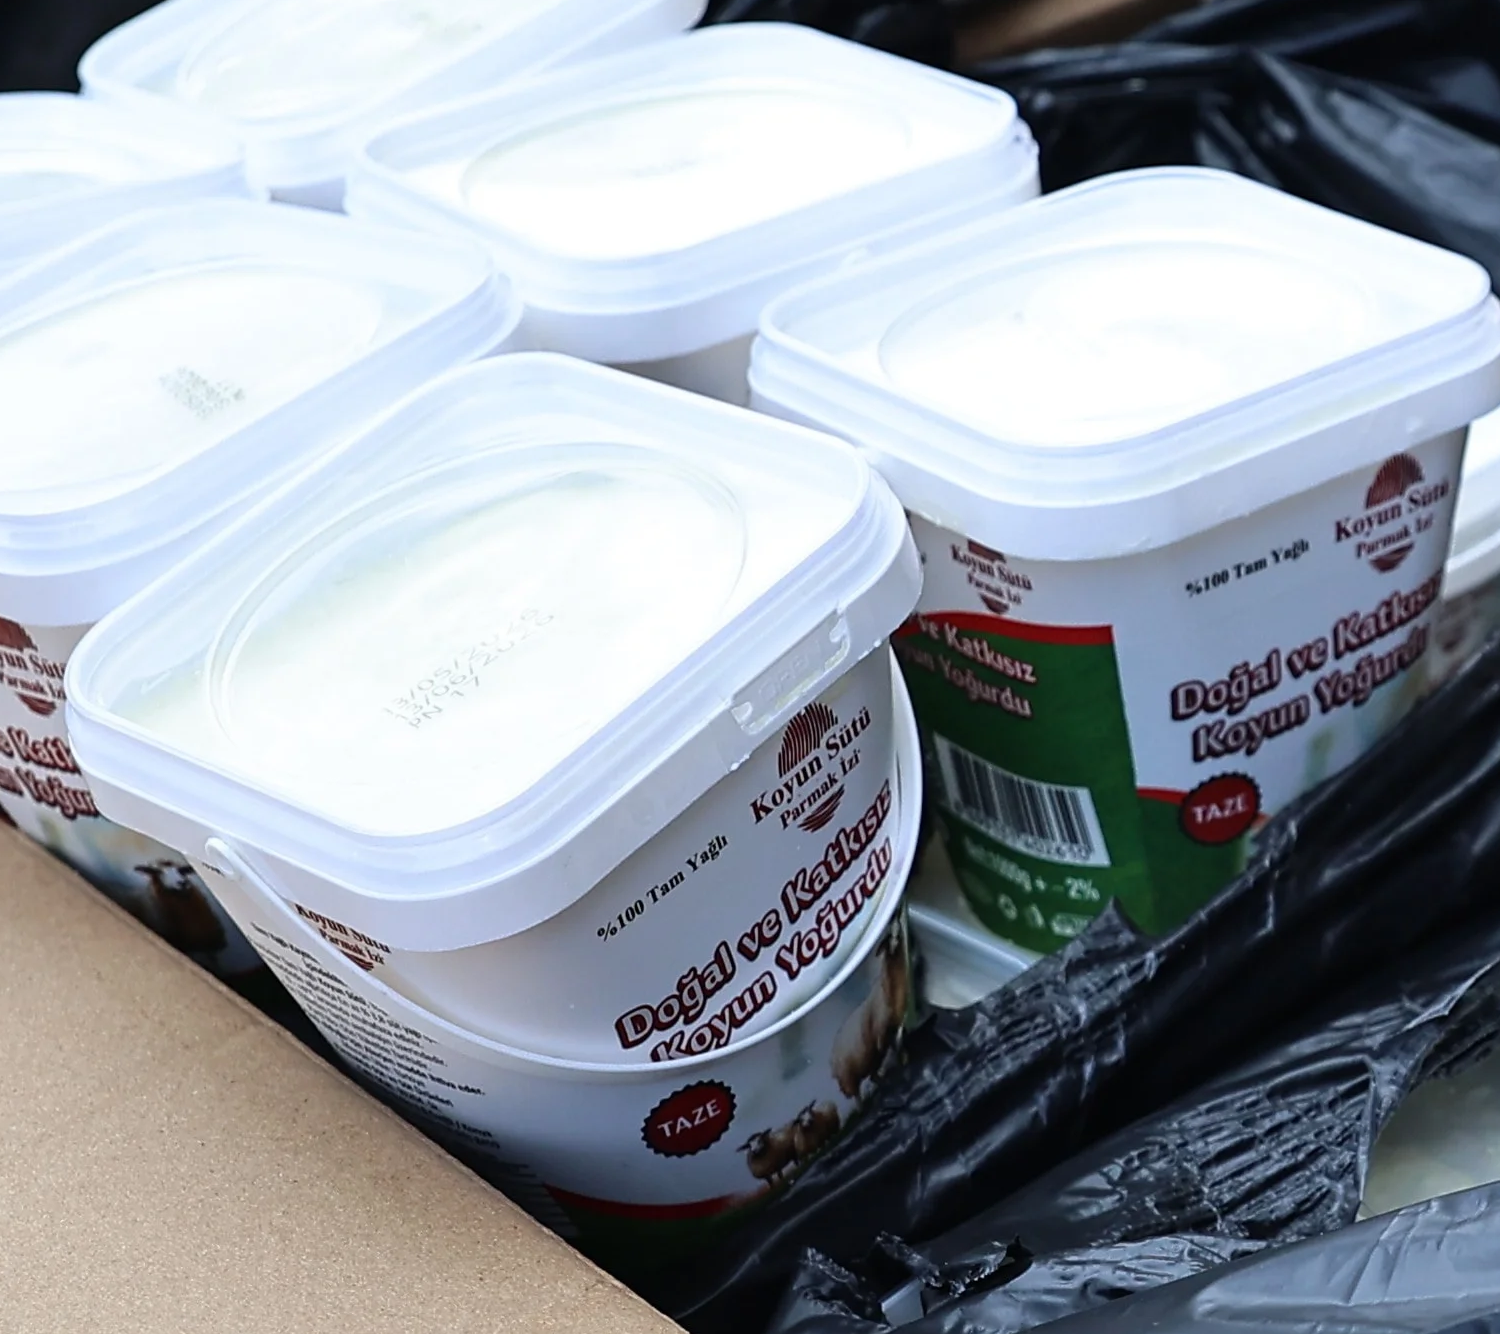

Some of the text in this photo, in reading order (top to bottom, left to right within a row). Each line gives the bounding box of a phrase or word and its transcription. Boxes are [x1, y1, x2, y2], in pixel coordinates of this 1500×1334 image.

[1334, 478, 1451, 544] Koyun Sütü
[1355, 527, 1411, 560] Parmak
[951, 544, 996, 579] Koyun
[1185, 539, 1311, 598] %100 Tam Yağlı
[916, 614, 1037, 684] ve Katkısız
[1171, 649, 1282, 722] Doğal
[1285, 637, 1329, 678] ve
[938, 654, 1033, 718] Yoğurdu
[1192, 693, 1311, 763] Koyun
[749, 706, 872, 825] Koyun Sütü
[779, 771, 839, 830] Parmak
[1191, 792, 1250, 823] TAZE
[596, 834, 730, 943] %100 Tam Yağlı
[615, 941, 736, 1049] Doğal
[737, 909, 782, 962] ve
[780, 779, 893, 924] Katkısız
[650, 970, 778, 1063] Koyun
[776, 837, 893, 981] Yoğurdu
[656, 1097, 723, 1141] TAZE
